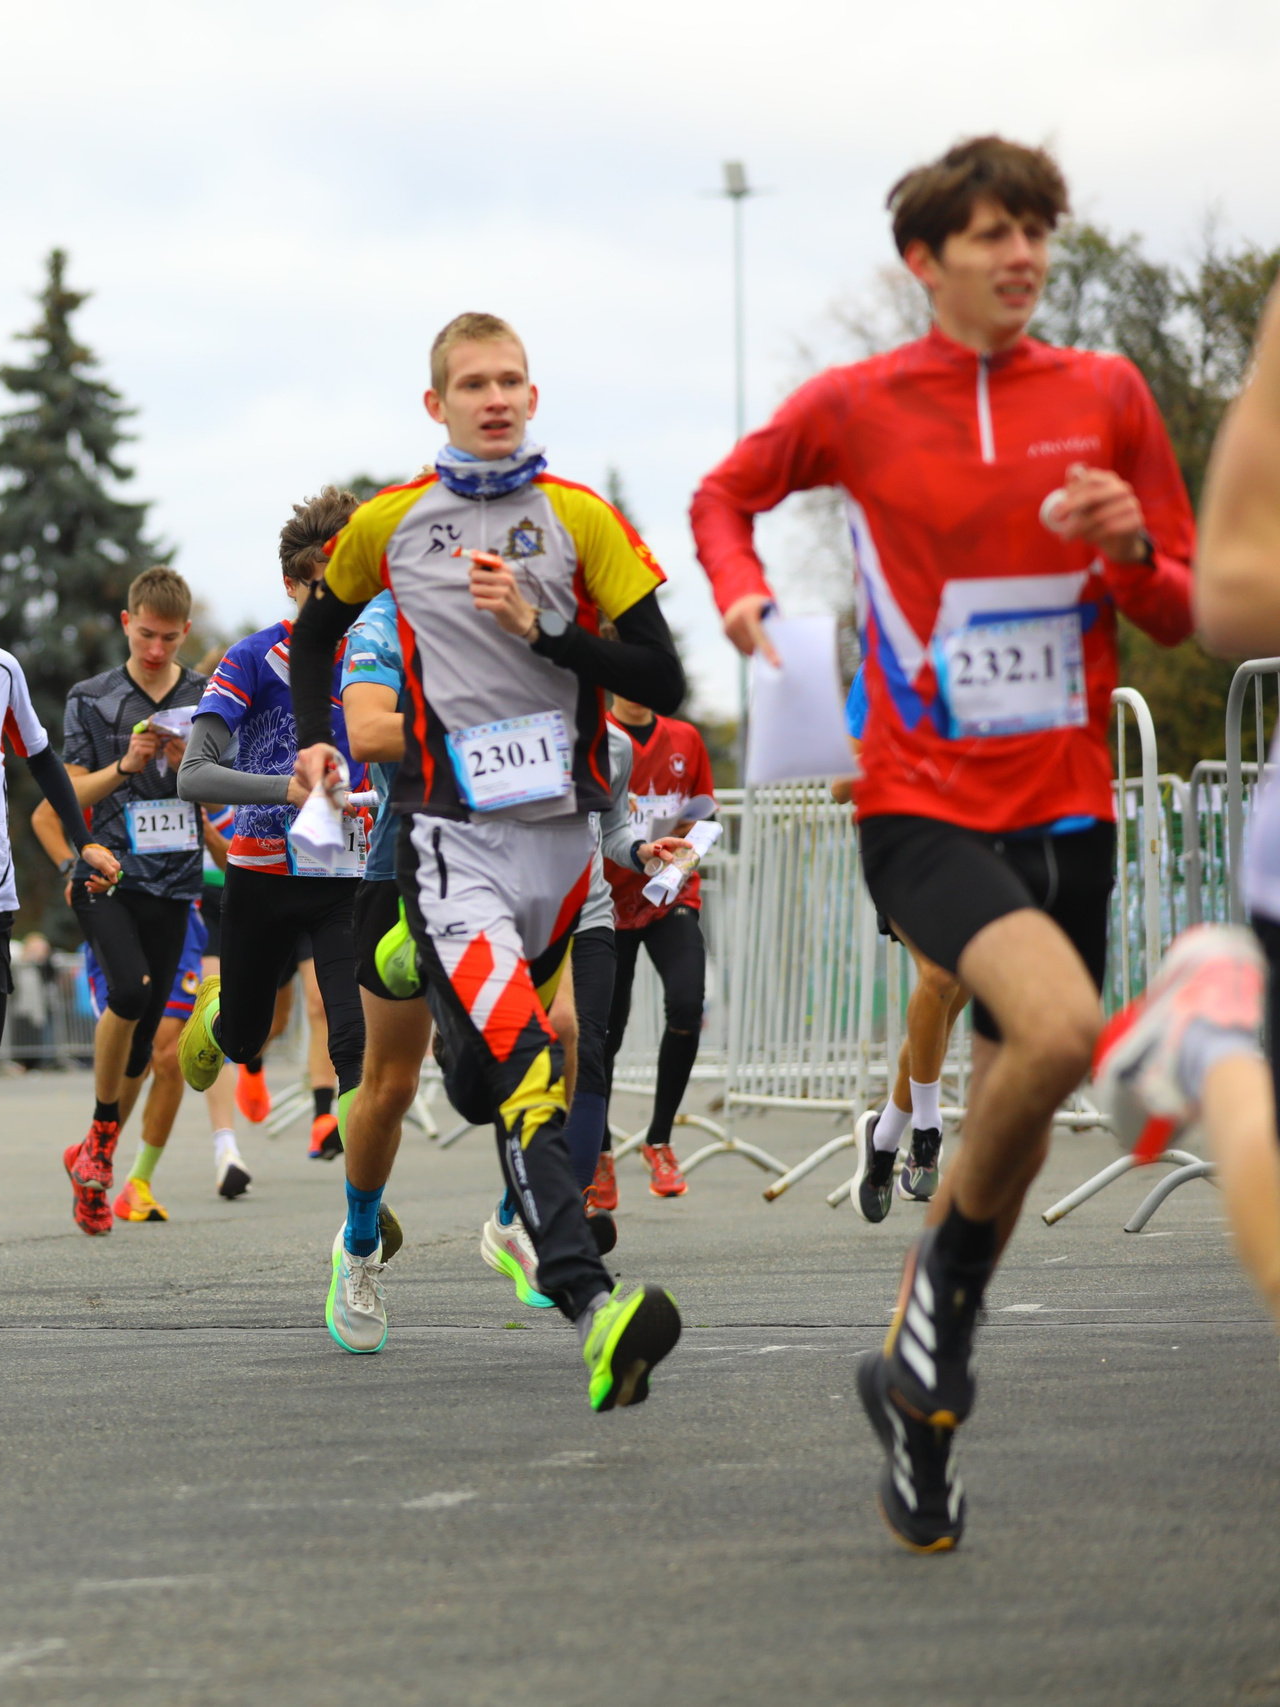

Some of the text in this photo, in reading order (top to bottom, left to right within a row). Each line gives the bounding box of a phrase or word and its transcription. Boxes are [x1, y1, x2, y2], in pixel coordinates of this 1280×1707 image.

[954, 645, 1053, 685] 232.1
[469, 737, 552, 777] 230.1
[137, 814, 184, 832] 212.1
